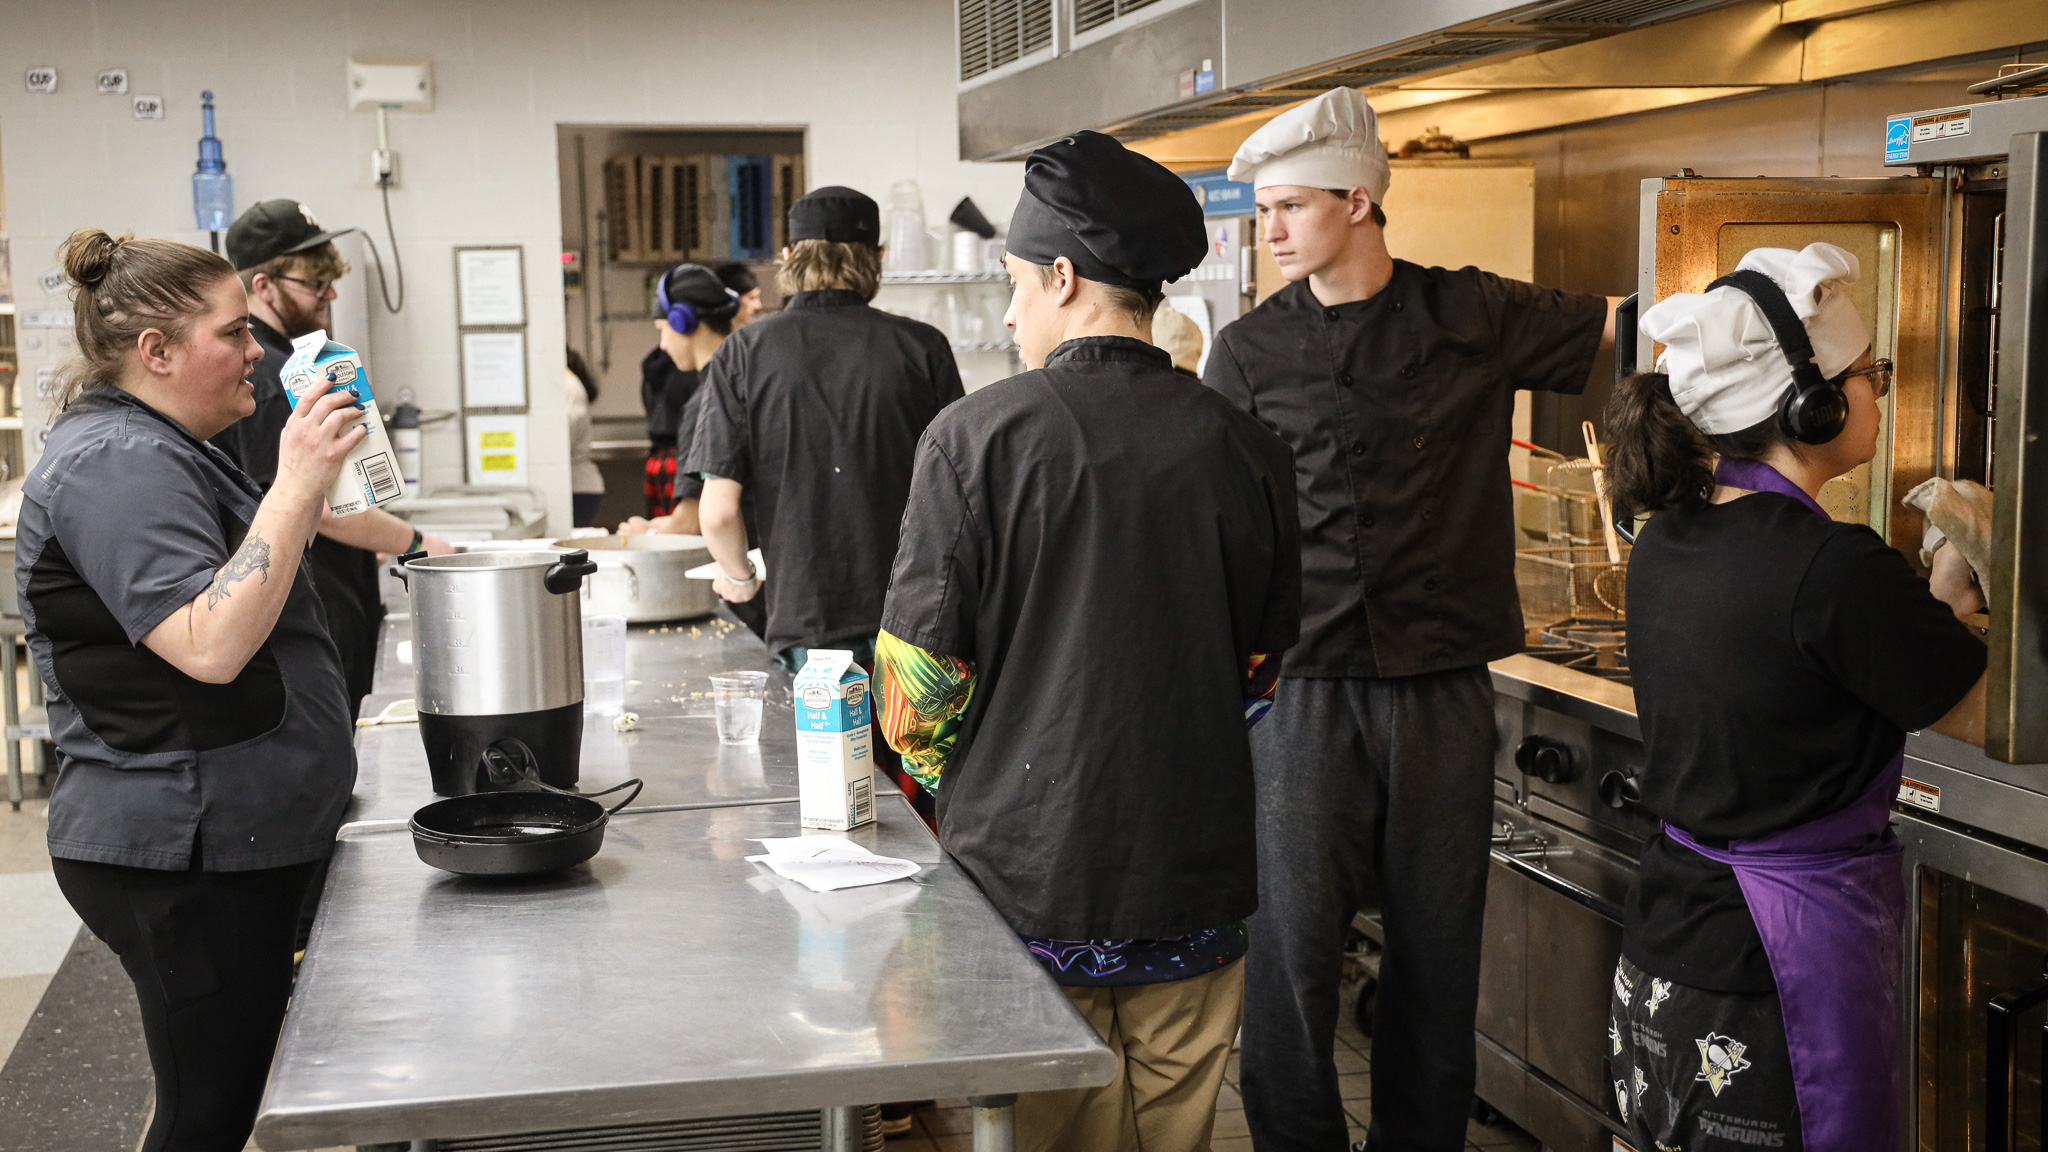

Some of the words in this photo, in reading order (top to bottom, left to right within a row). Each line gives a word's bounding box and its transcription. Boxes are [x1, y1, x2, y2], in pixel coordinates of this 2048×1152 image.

[807, 711, 820, 719] Half
[821, 712, 827, 720] &
[849, 708, 858, 717] Half
[811, 721, 824, 729] Half
[852, 717, 862, 726] Half
[1702, 1109, 1778, 1130] PITTSBURGH
[1697, 1116, 1785, 1148] PENGUINS
